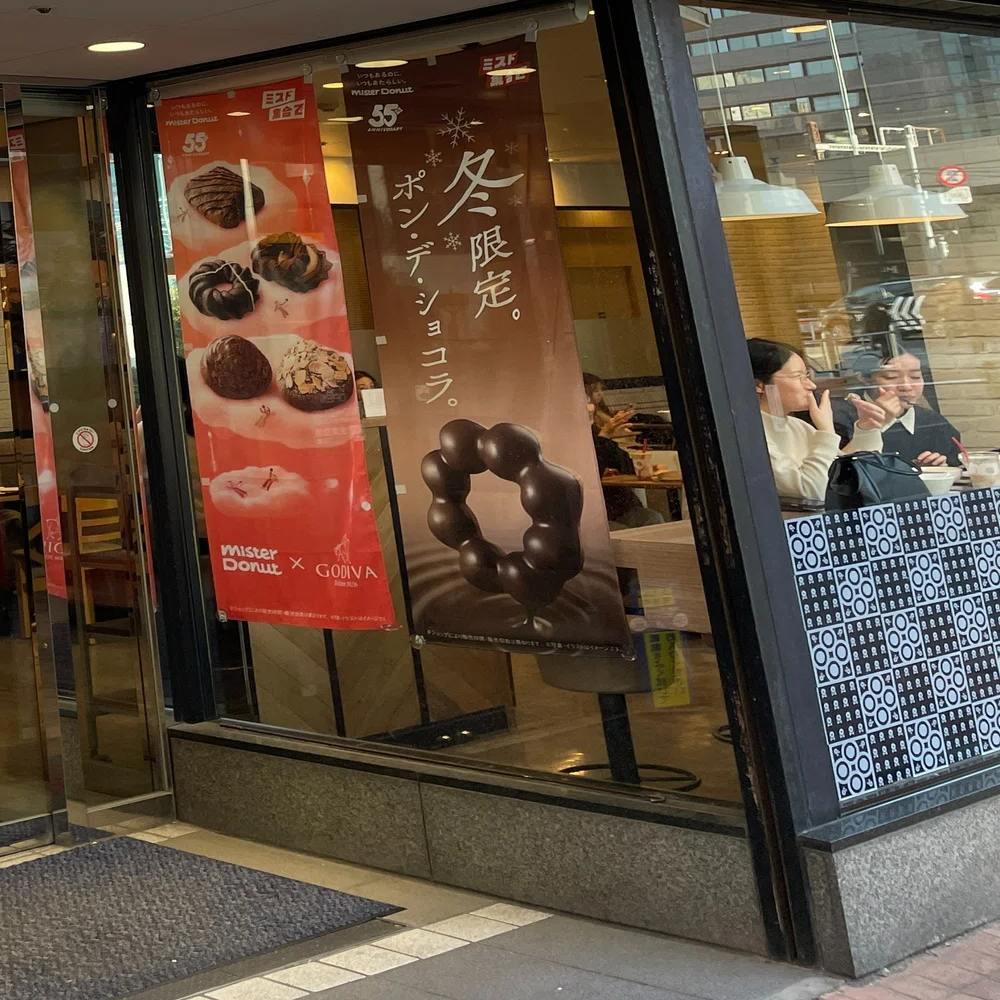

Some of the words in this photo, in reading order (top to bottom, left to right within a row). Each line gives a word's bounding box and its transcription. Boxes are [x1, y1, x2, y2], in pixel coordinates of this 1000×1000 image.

[483, 53, 518, 71] ミスド
[264, 91, 292, 106] ミスド
[381, 86, 414, 95] Donut
[191, 115, 219, 125] Donut
[271, 103, 305, 119] 集合で
[368, 103, 399, 128] 55
[182, 131, 207, 153] 55
[437, 148, 524, 322] 冬限定。
[222, 557, 283, 576] Donut
[315, 563, 378, 580] GODIVA
